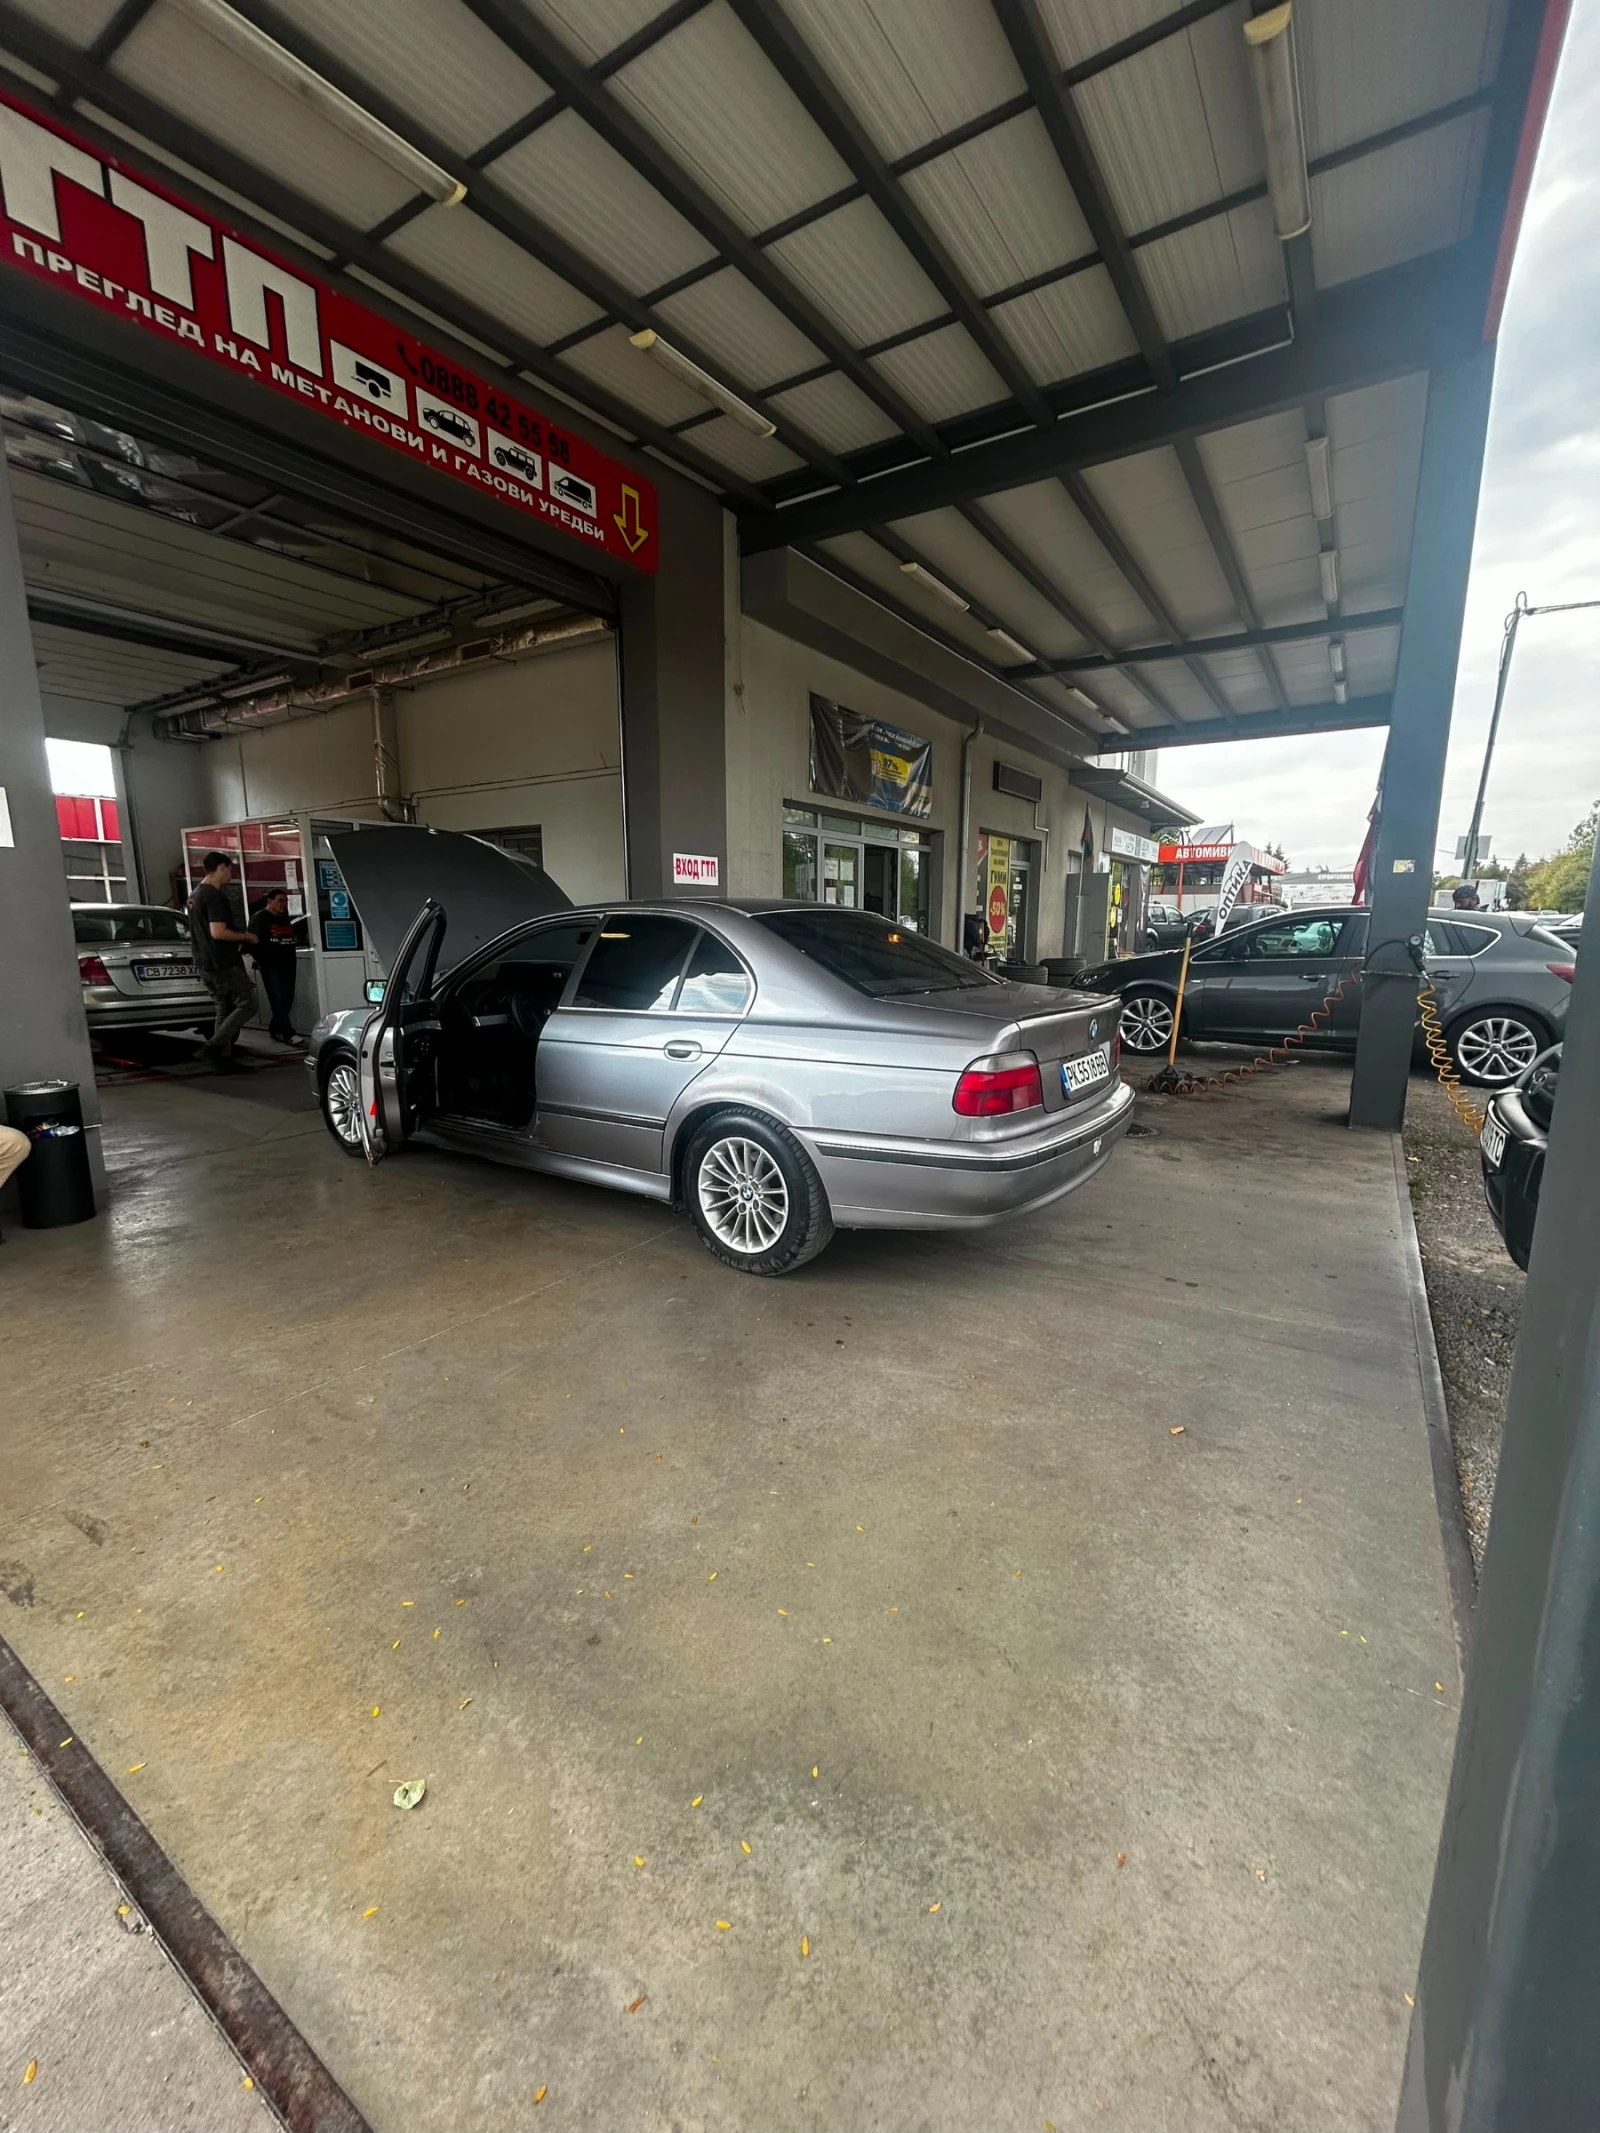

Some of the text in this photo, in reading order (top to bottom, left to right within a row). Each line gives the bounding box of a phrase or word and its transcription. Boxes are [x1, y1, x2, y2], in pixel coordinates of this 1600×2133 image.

[0, 103, 323, 378] ГТП
[12, 232, 604, 542] ПРЕГЛЕД НА МЕТАНОВИ И ГАЗОВИ УРЕДБИ
[420, 357, 571, 464] 0888 42 55 58
[676, 857, 716, 880] ВХОД ГТП
[990, 870, 1006, 884] ГУМИ
[1175, 846, 1235, 859] АВТОМИВК
[1219, 860, 1253, 920] ОПТИКА
